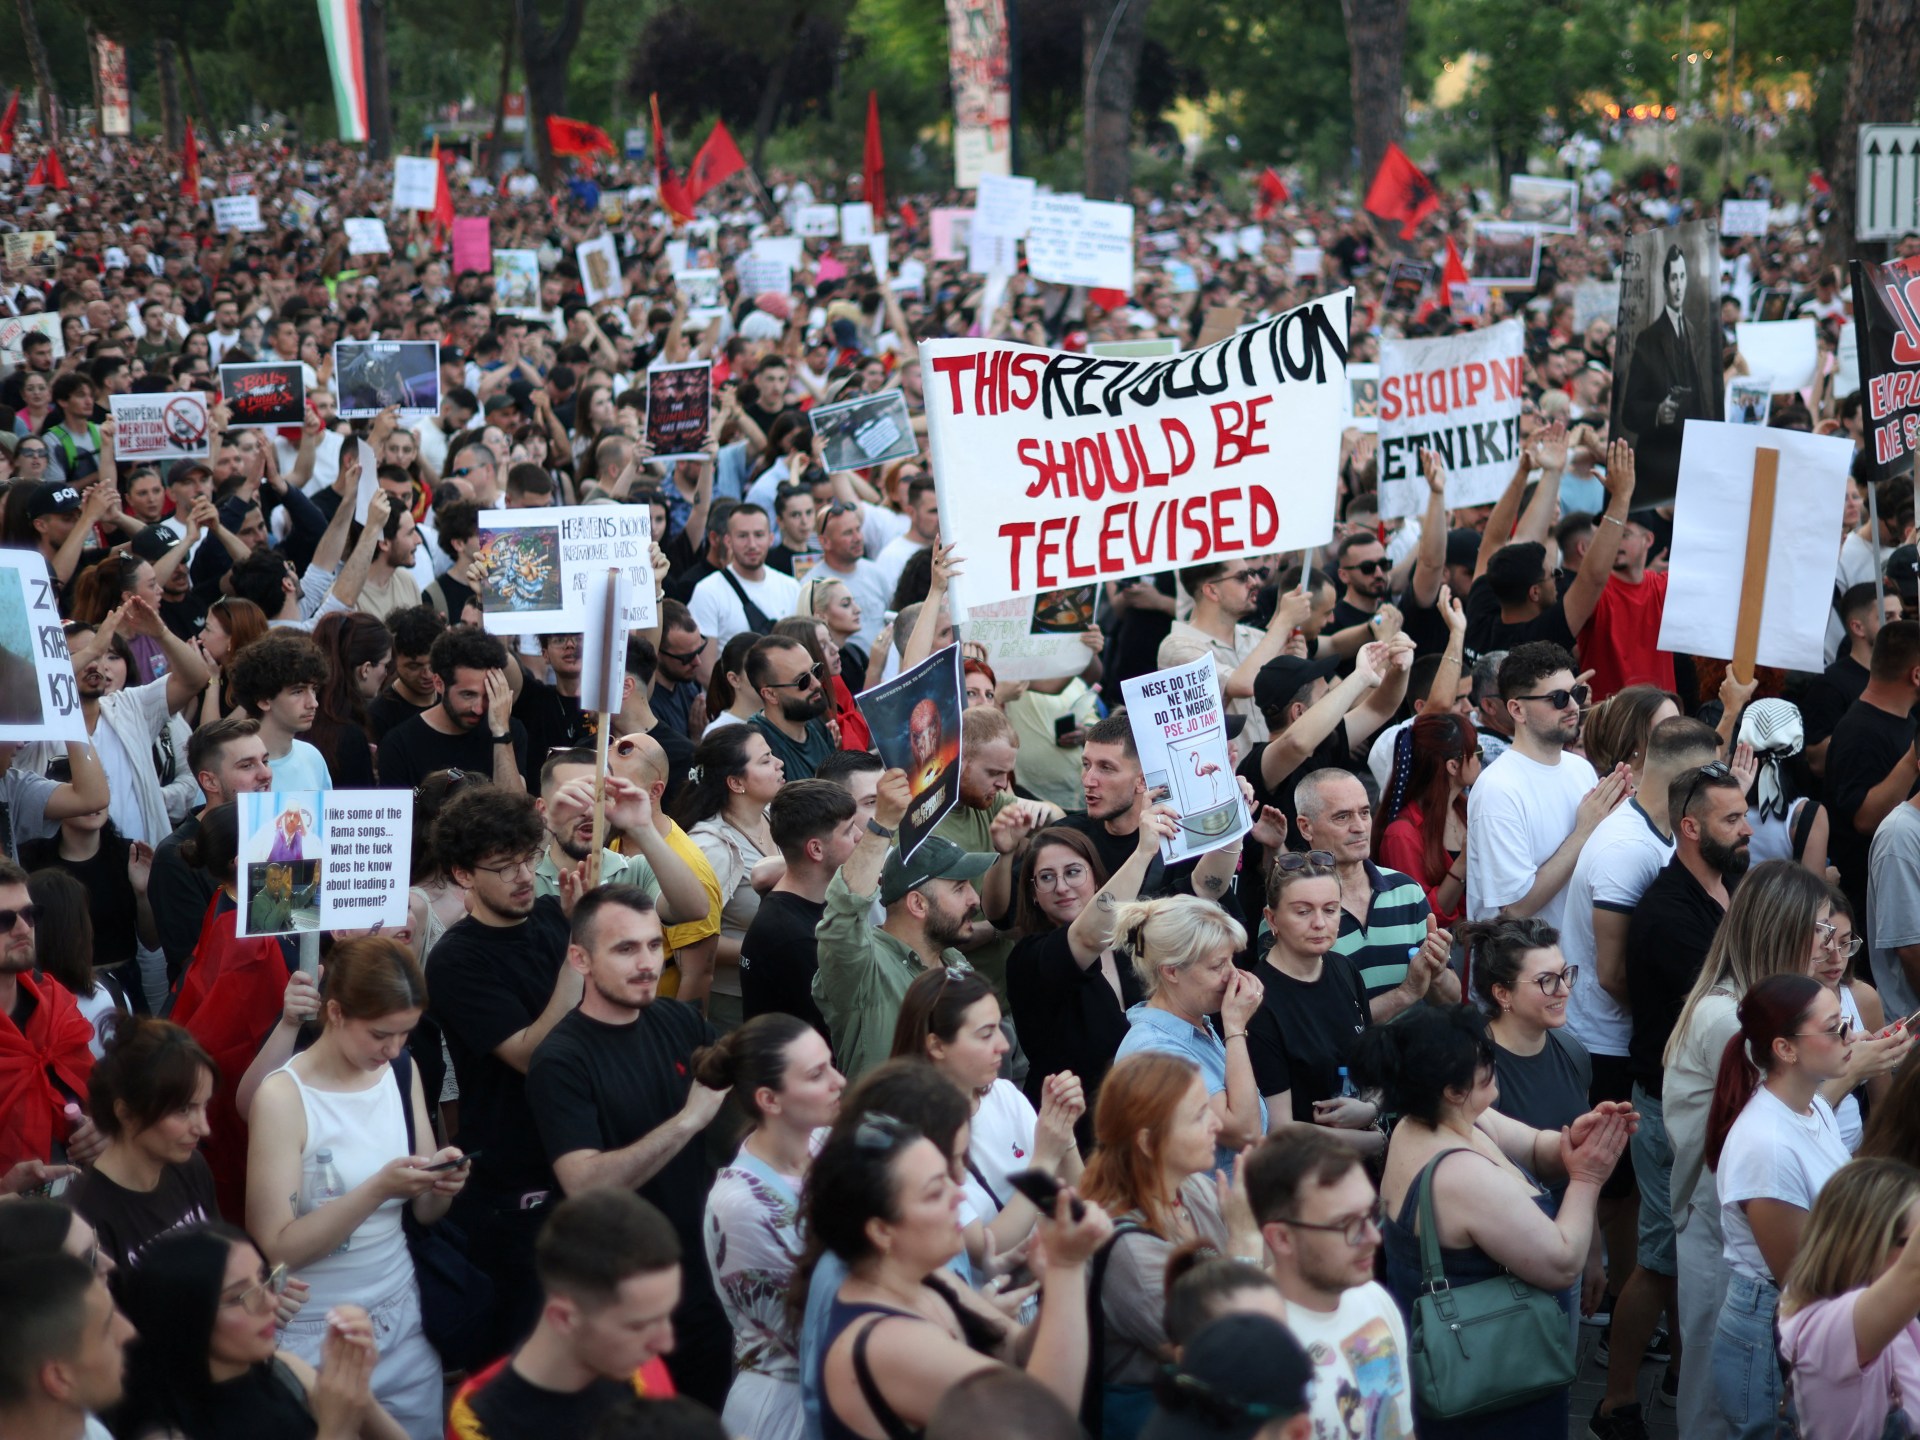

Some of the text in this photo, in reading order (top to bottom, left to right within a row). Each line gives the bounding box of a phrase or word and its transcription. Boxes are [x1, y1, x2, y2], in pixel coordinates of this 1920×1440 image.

[933, 296, 1353, 418] THIS REVOLUTION
[1017, 395, 1274, 500] SHOULD BE
[998, 485, 1279, 591] TELEVISED
[1141, 680, 1168, 699] NËSE
[1169, 676, 1185, 691] DO
[1154, 710, 1170, 726] DO
[1170, 707, 1185, 722] TA
[1163, 722, 1185, 739] PSE
[1186, 717, 1199, 733] JO
[329, 808, 345, 820] like
[347, 808, 373, 819] some
[375, 808, 384, 819] of
[387, 807, 402, 819] the
[330, 826, 394, 838] Rama songs...
[330, 842, 393, 855] What the fuck
[329, 860, 393, 873] does he know
[326, 877, 396, 891] about leading a
[332, 895, 387, 909] goverment?
